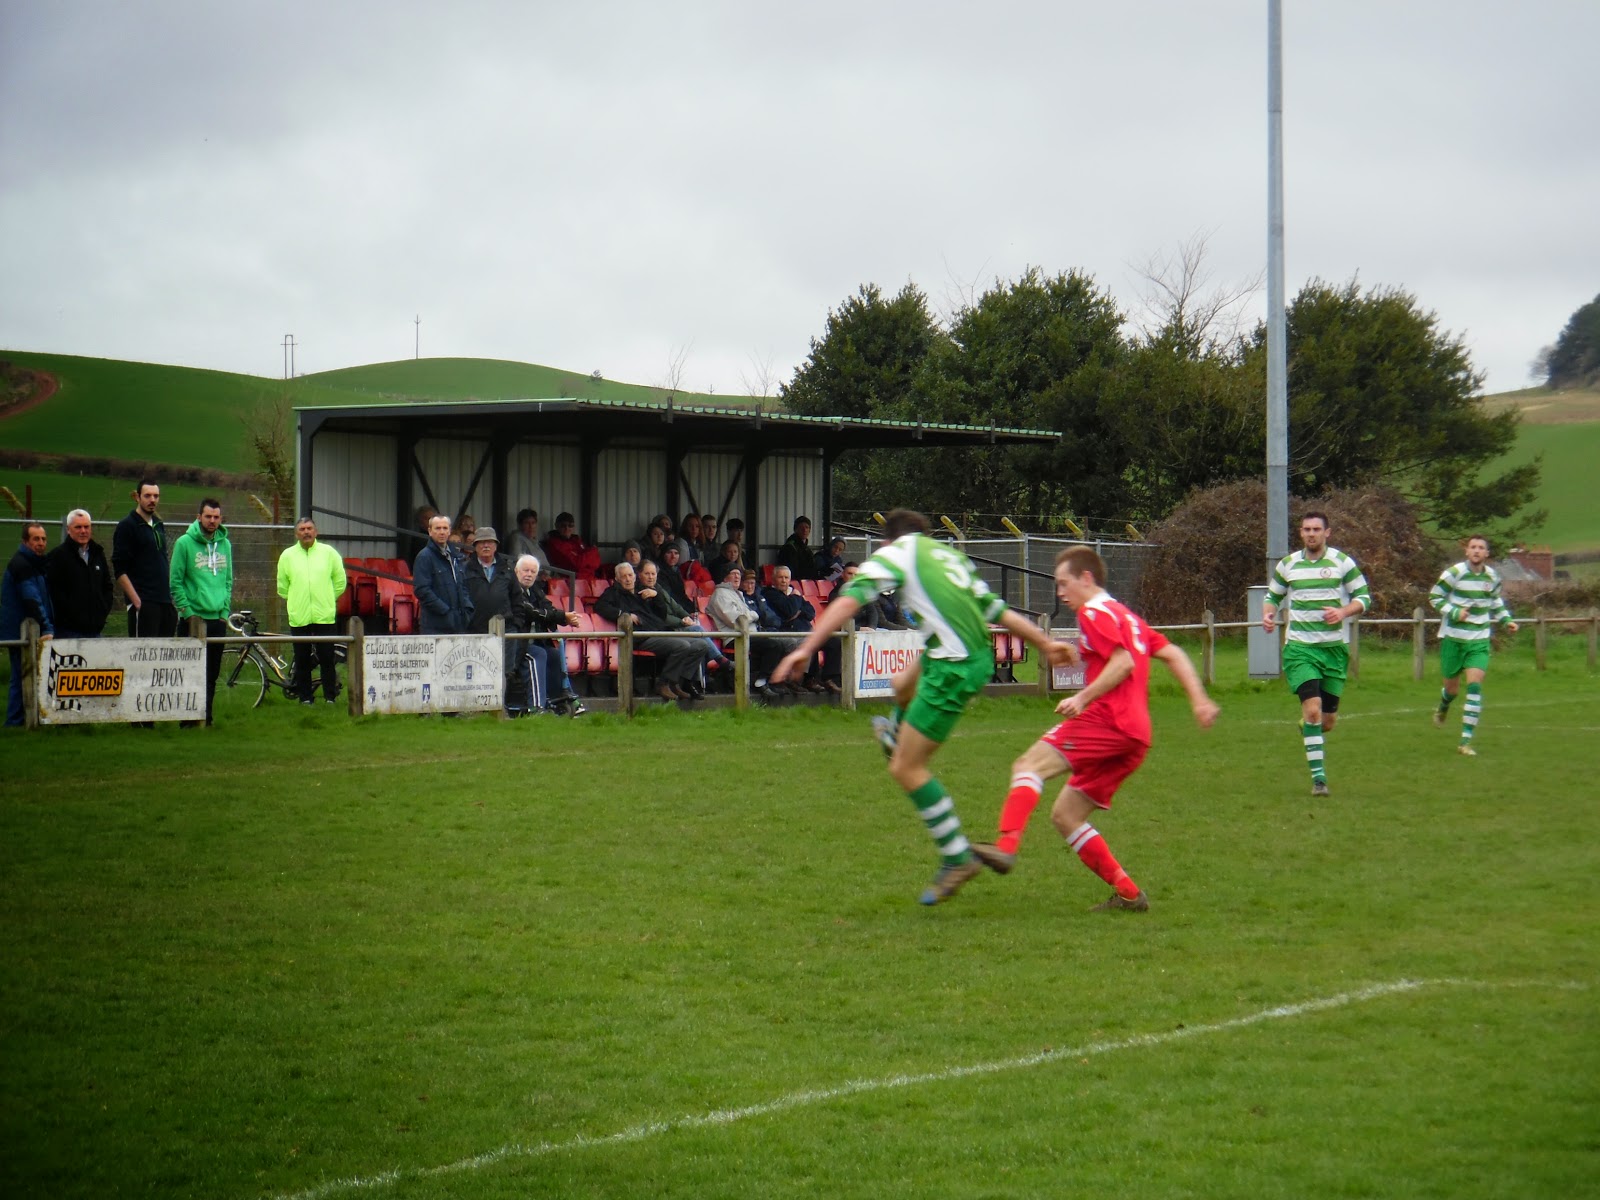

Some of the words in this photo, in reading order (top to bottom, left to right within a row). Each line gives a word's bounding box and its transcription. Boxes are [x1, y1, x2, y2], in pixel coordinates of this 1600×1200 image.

[159, 647, 203, 662] THROUGHOUT
[372, 660, 398, 669] BUDLEIGH
[399, 659, 429, 669] SALTERTON
[58, 674, 121, 692] FULFORDS
[151, 667, 185, 688] DEVON
